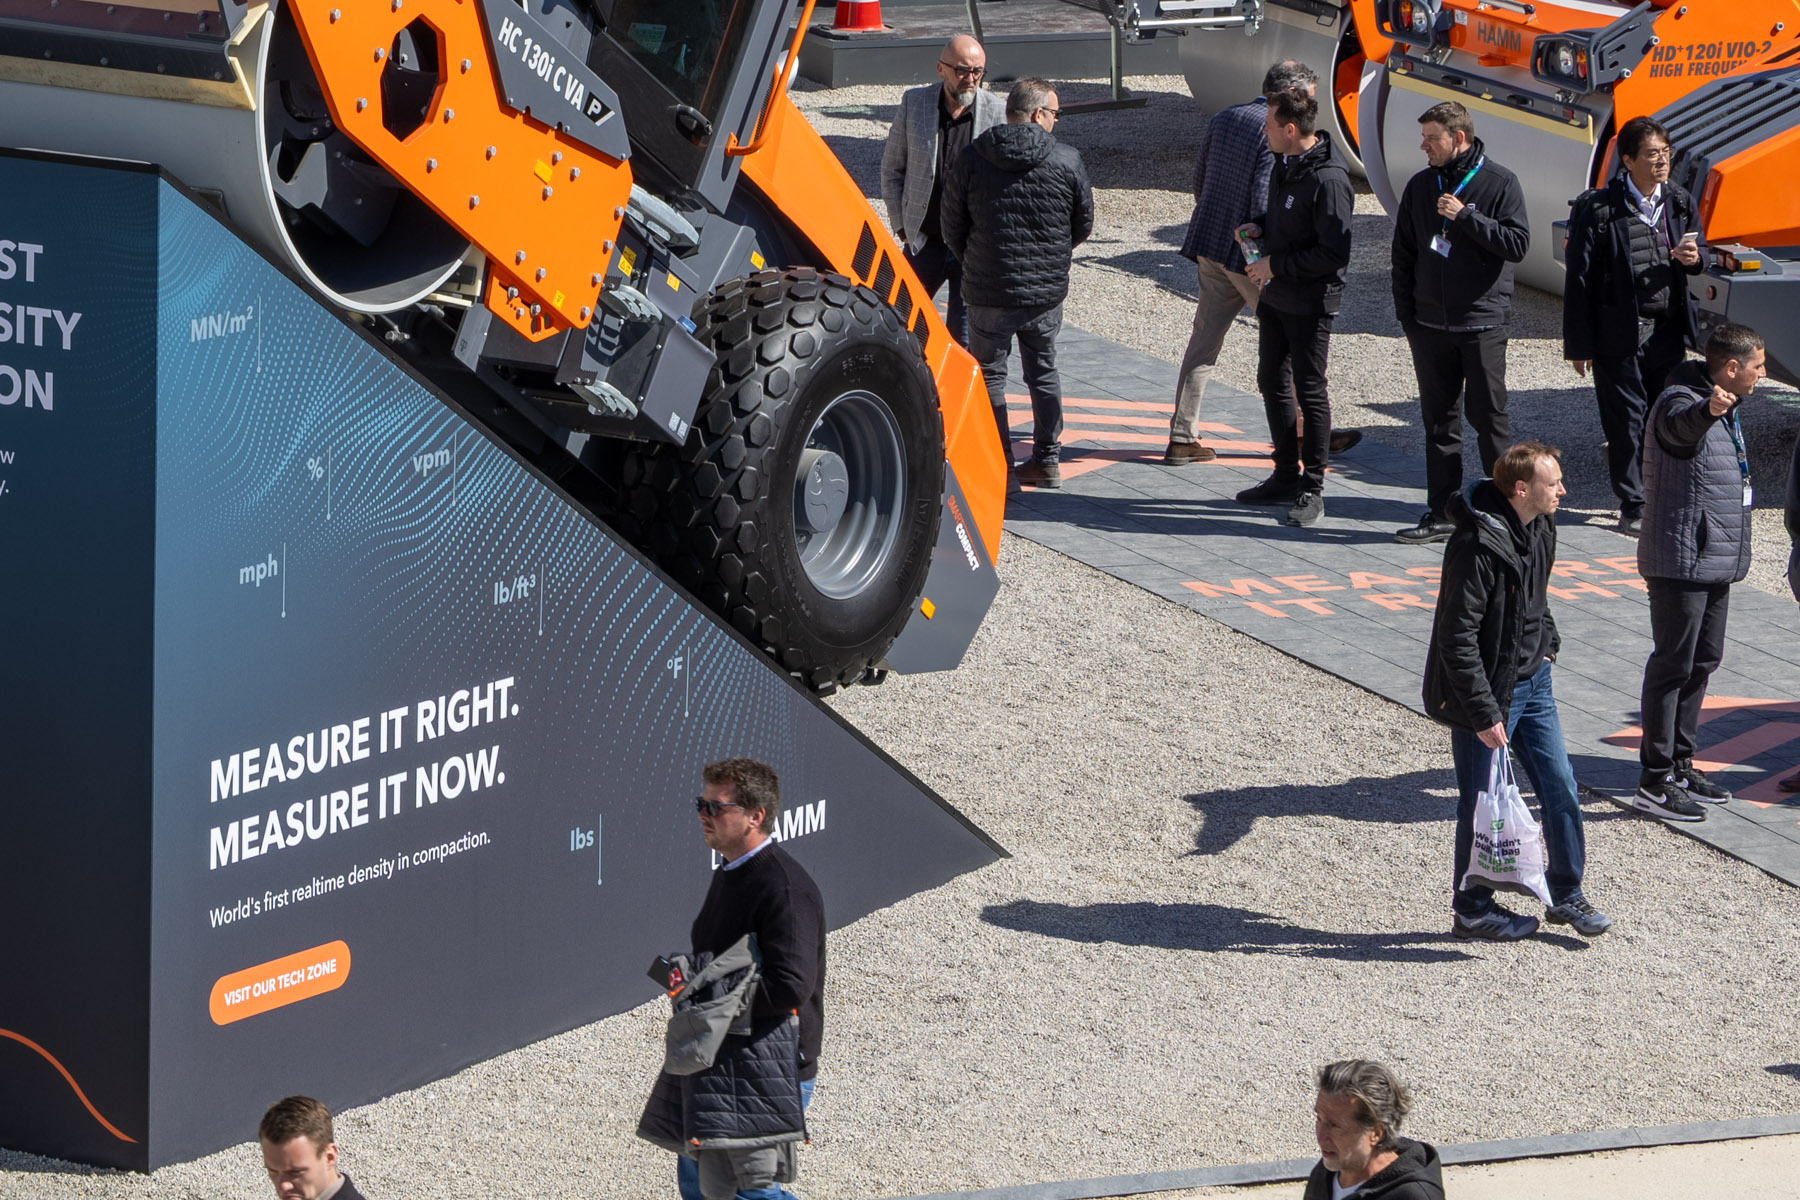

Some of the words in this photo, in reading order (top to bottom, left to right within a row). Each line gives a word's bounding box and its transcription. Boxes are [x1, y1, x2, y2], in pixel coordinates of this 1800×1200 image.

[1476, 20, 1522, 53] HAMM
[1685, 42, 1724, 62] 120i
[498, 16, 523, 53] HC
[521, 38, 555, 82] 130i
[553, 65, 567, 93] C
[564, 73, 585, 111] VA
[1650, 64, 1683, 79] HIGH
[307, 456, 324, 482] %
[413, 446, 451, 477] vpm
[947, 494, 963, 524] SMART
[955, 522, 980, 571] COMPACT
[239, 554, 279, 590] mph
[1242, 597, 1336, 619] IT
[209, 717, 371, 803] MEASURE
[379, 705, 408, 755] IT
[416, 676, 520, 745] RIGHT.
[209, 785, 371, 871] MEASURE
[378, 774, 408, 824] IT
[415, 746, 506, 816] NOW.
[771, 799, 827, 843] AMM
[570, 826, 594, 852] lbs
[1475, 831, 1489, 844] We
[1501, 848, 1520, 857] bag
[1477, 860, 1491, 871] our
[1492, 862, 1517, 874] tires.
[1478, 852, 1488, 861] as
[209, 894, 261, 929] World's
[263, 884, 289, 913] first
[292, 873, 346, 904] realtime
[348, 860, 395, 894] density
[398, 853, 410, 874] in
[412, 830, 492, 870] compaction.
[223, 987, 249, 1007] VISIT
[251, 980, 275, 1001] OUR
[276, 971, 305, 994] TECH
[306, 959, 338, 986] ZONE
